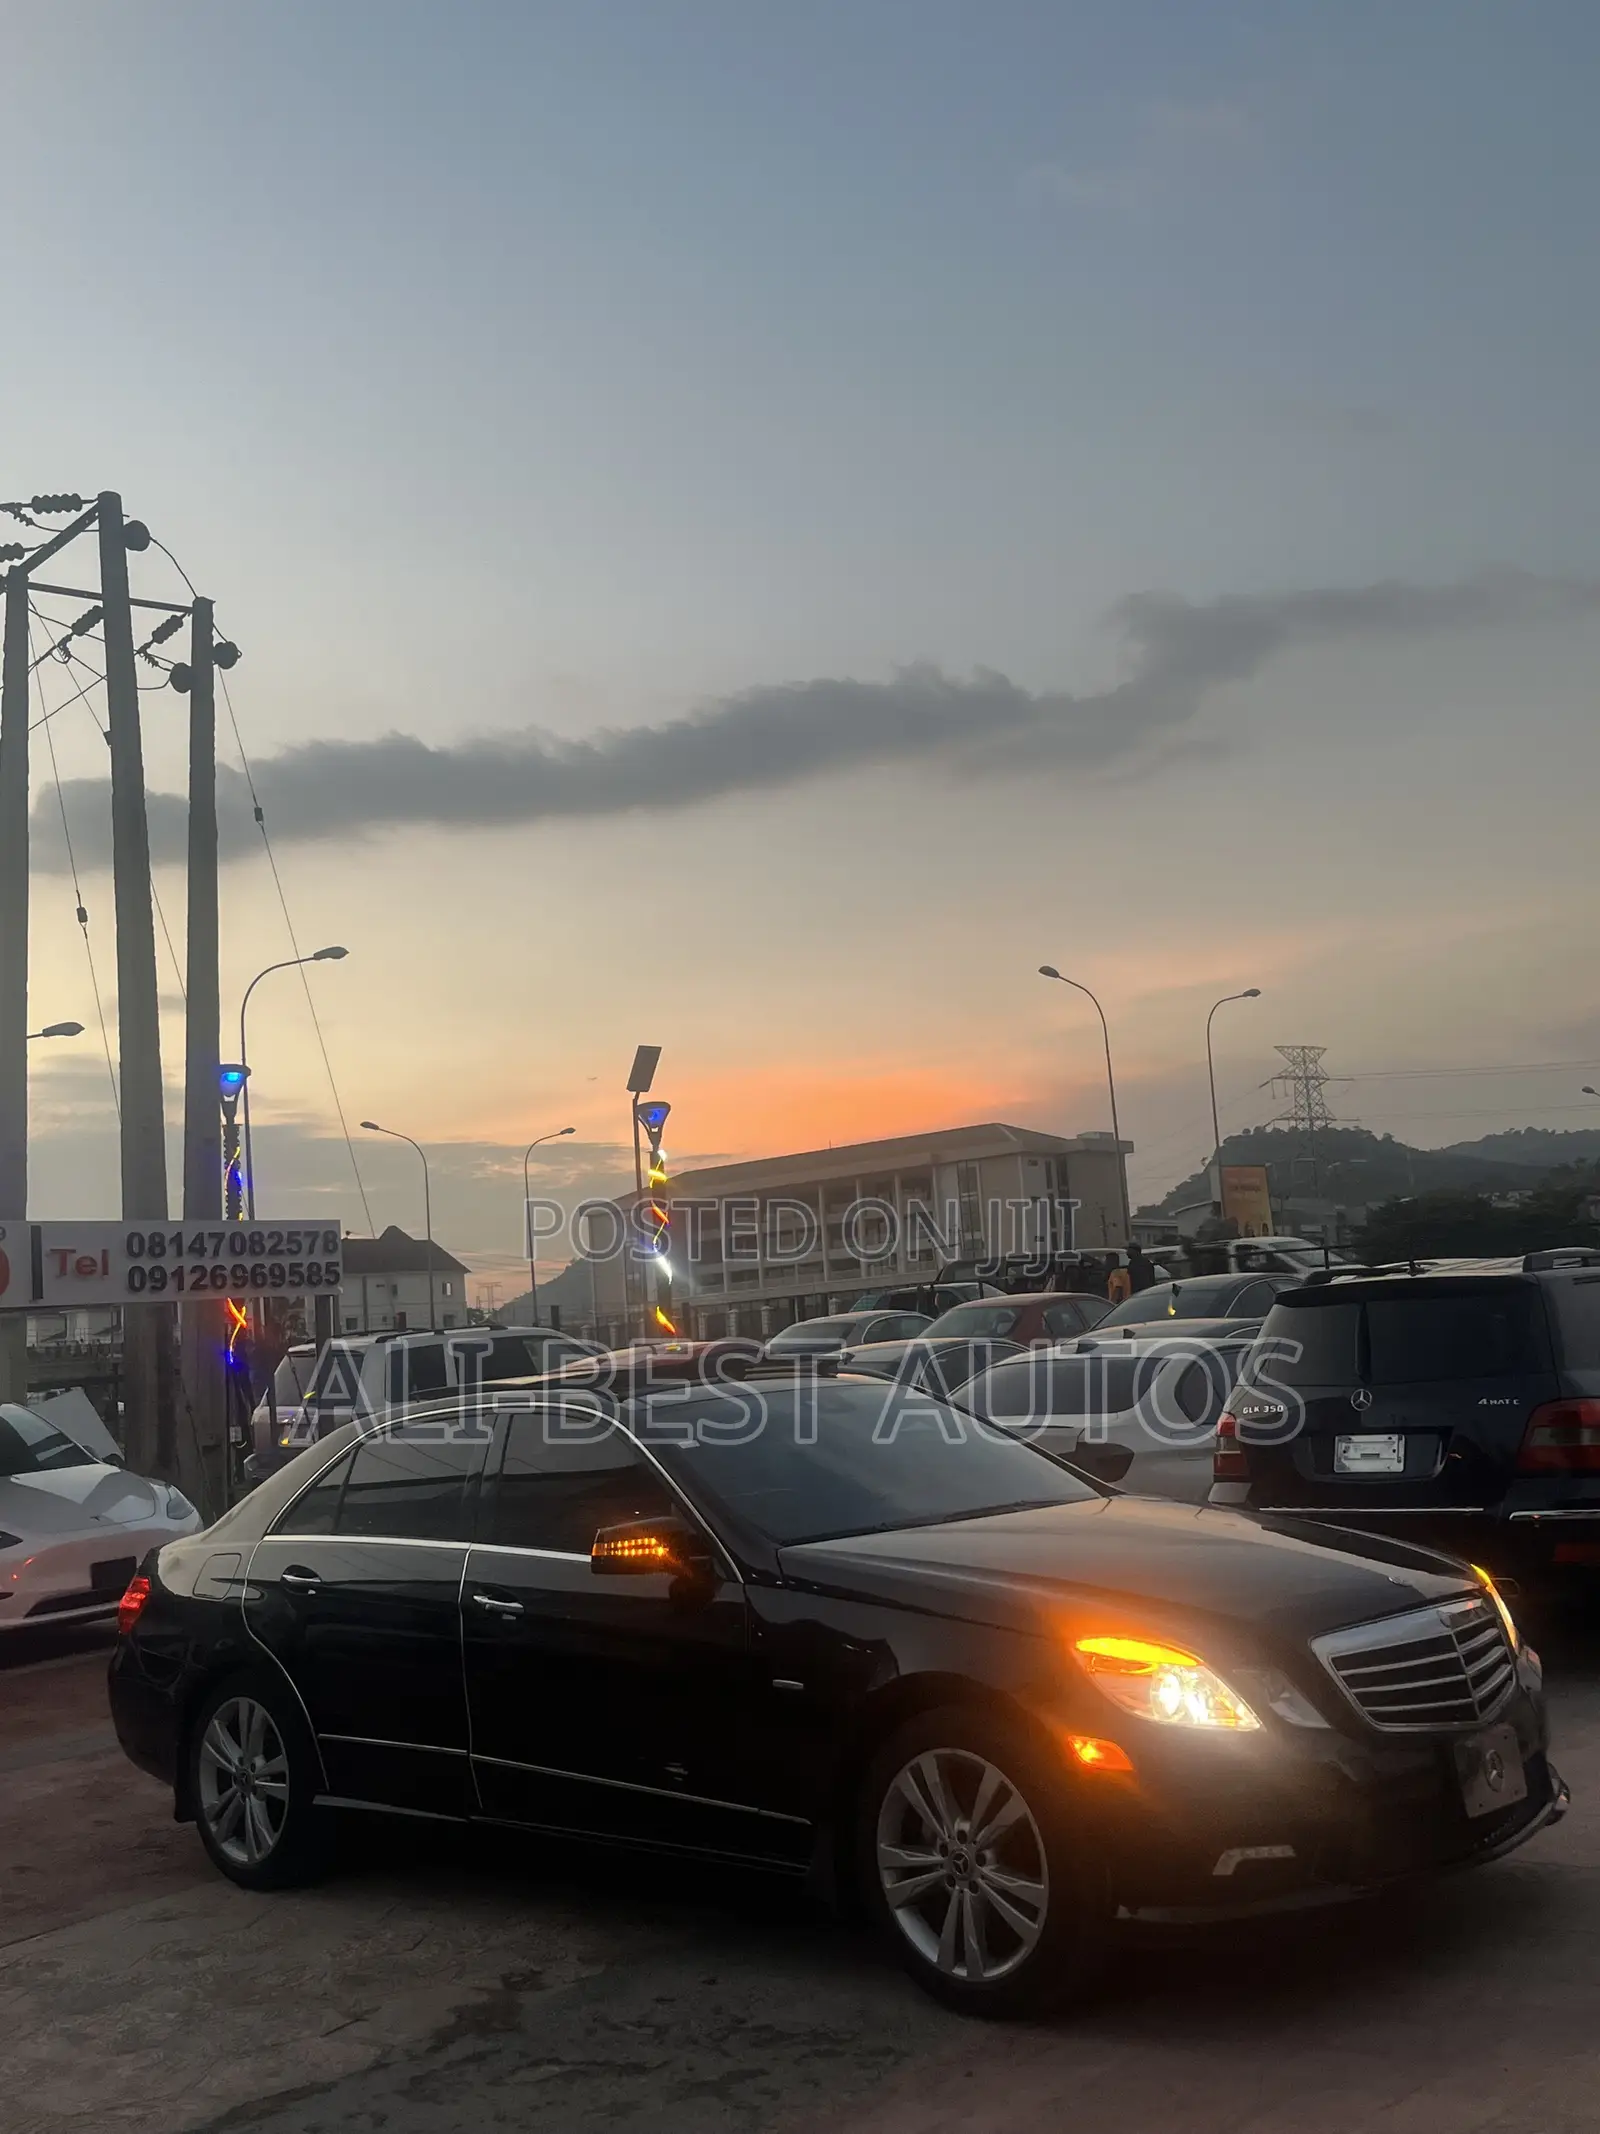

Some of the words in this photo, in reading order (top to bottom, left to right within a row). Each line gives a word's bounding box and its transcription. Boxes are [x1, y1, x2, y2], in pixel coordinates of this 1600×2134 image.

[126, 1230, 339, 1258] 08147082578
[48, 1249, 109, 1276] Tel
[128, 1261, 341, 1292] 09126969585
[1242, 1405, 1260, 1414] GLK
[1263, 1404, 1284, 1413] 350
